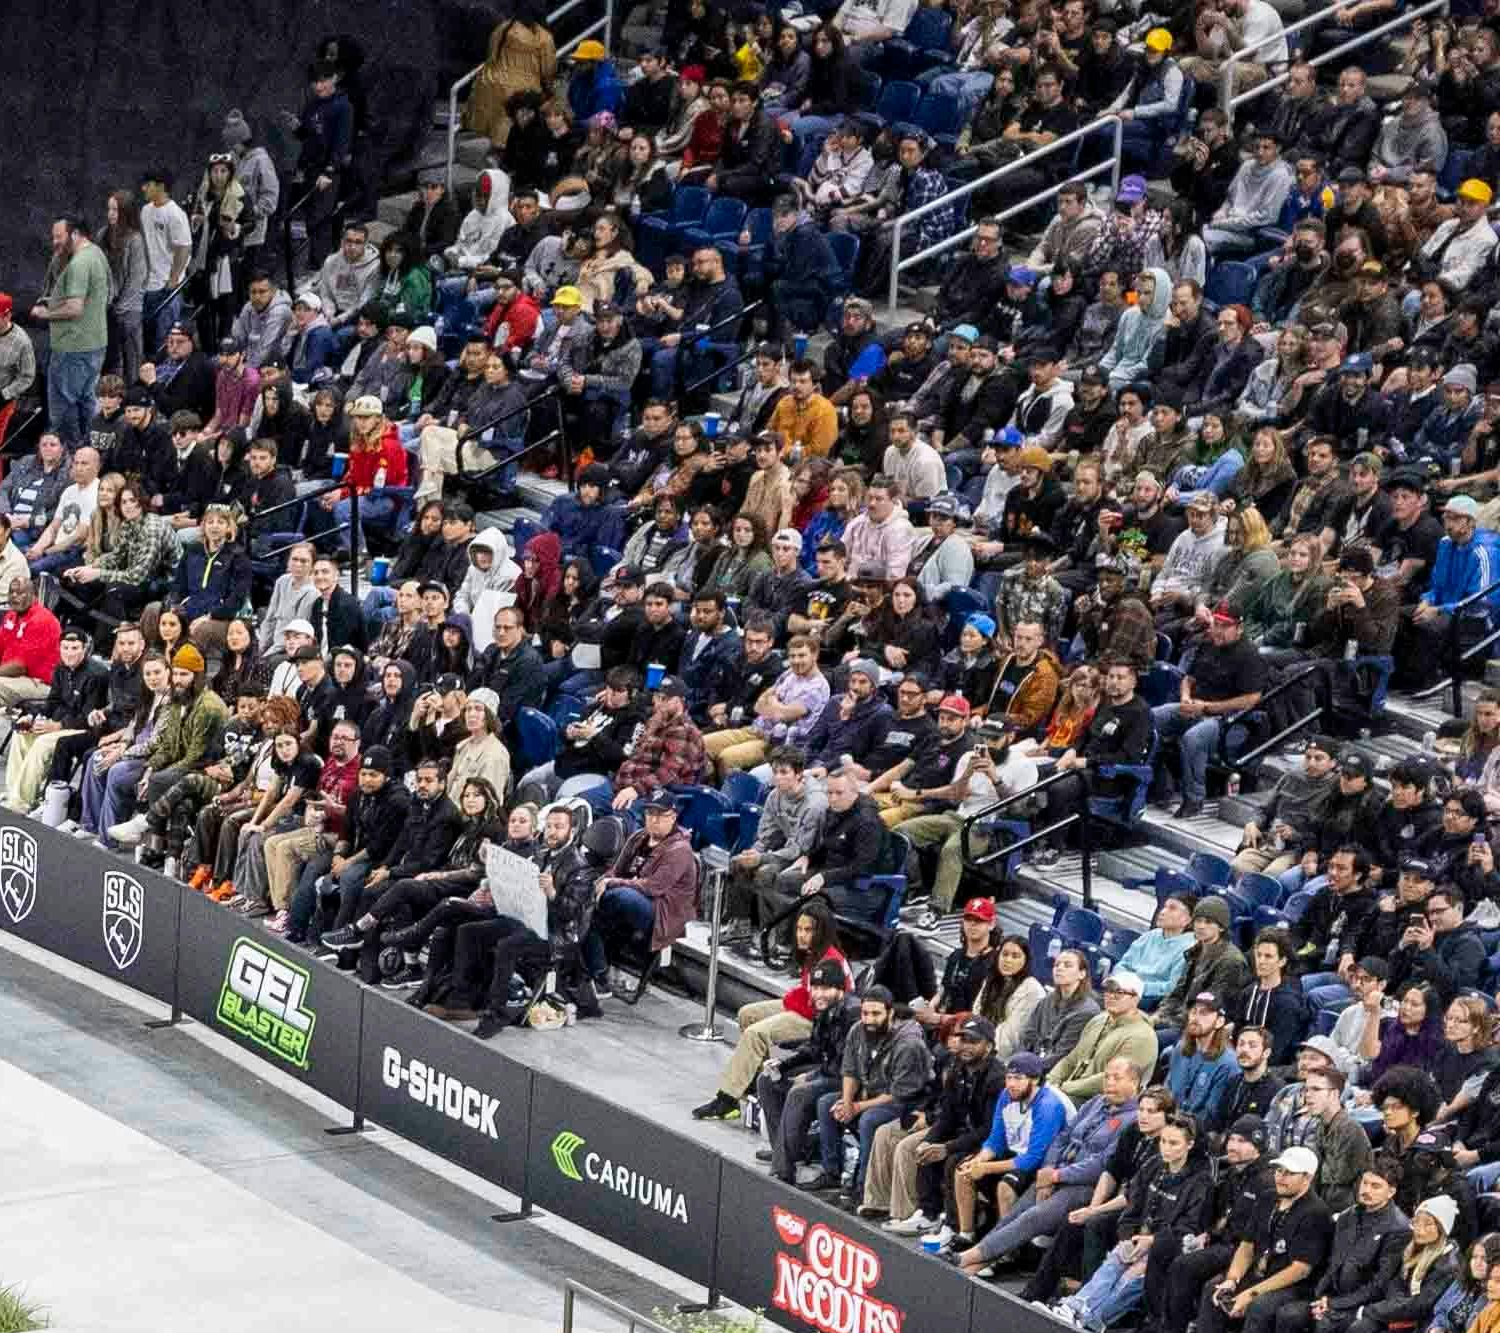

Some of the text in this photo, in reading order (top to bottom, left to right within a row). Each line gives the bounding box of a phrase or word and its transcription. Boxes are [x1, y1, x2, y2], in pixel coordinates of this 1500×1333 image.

[2, 831, 35, 874] SLS
[106, 877, 140, 920] SLS
[229, 943, 312, 1032] GEL
[220, 990, 306, 1060] BLASTER
[382, 1045, 501, 1140] G-SHOCK
[584, 1151, 689, 1225] CARIUMA
[809, 1227, 881, 1297] CUP
